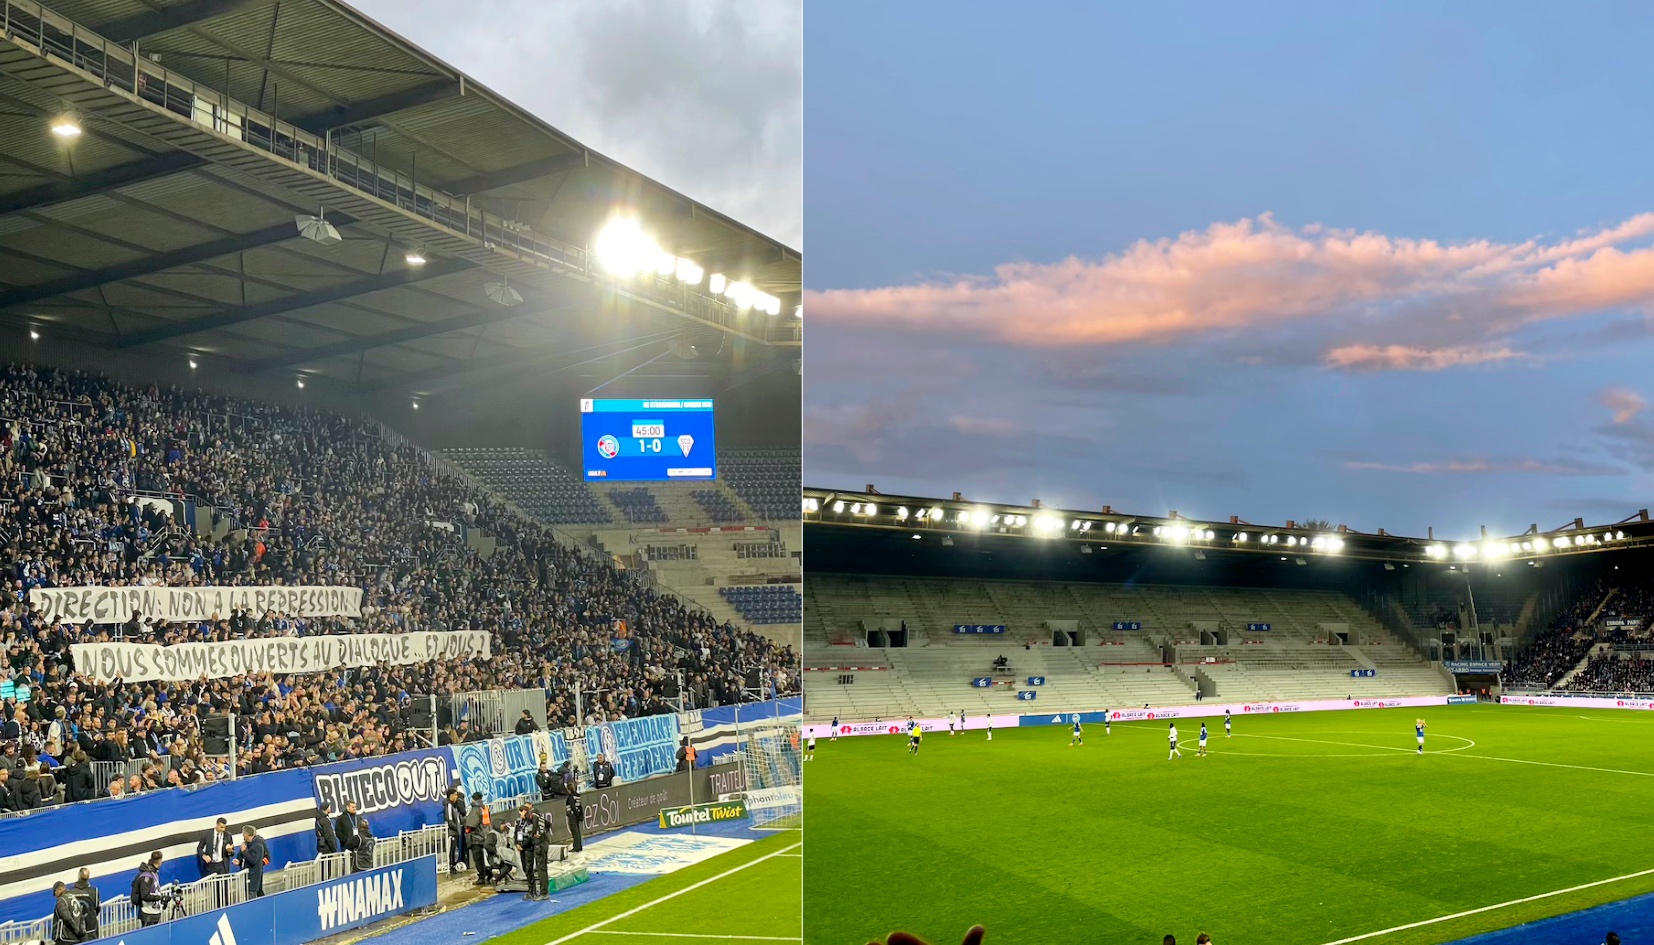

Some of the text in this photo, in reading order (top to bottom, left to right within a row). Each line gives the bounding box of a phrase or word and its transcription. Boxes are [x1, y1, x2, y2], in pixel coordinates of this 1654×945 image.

[636, 427, 661, 436] 45:00
[638, 438, 661, 453] 1-0
[170, 591, 206, 617] NON
[230, 591, 250, 611] LA
[82, 647, 149, 678] NOUS
[153, 646, 228, 677] SOMMES
[231, 641, 308, 673] OUVERTS
[313, 641, 331, 665] AU
[442, 633, 474, 657] VOUS
[317, 766, 397, 816] BLUECO
[396, 756, 448, 804] OUT!
[601, 792, 620, 826] Soi
[627, 796, 649, 810] Créateur
[650, 794, 656, 805] de
[710, 806, 743, 820] Twist
[317, 868, 404, 931] WINAMAX
